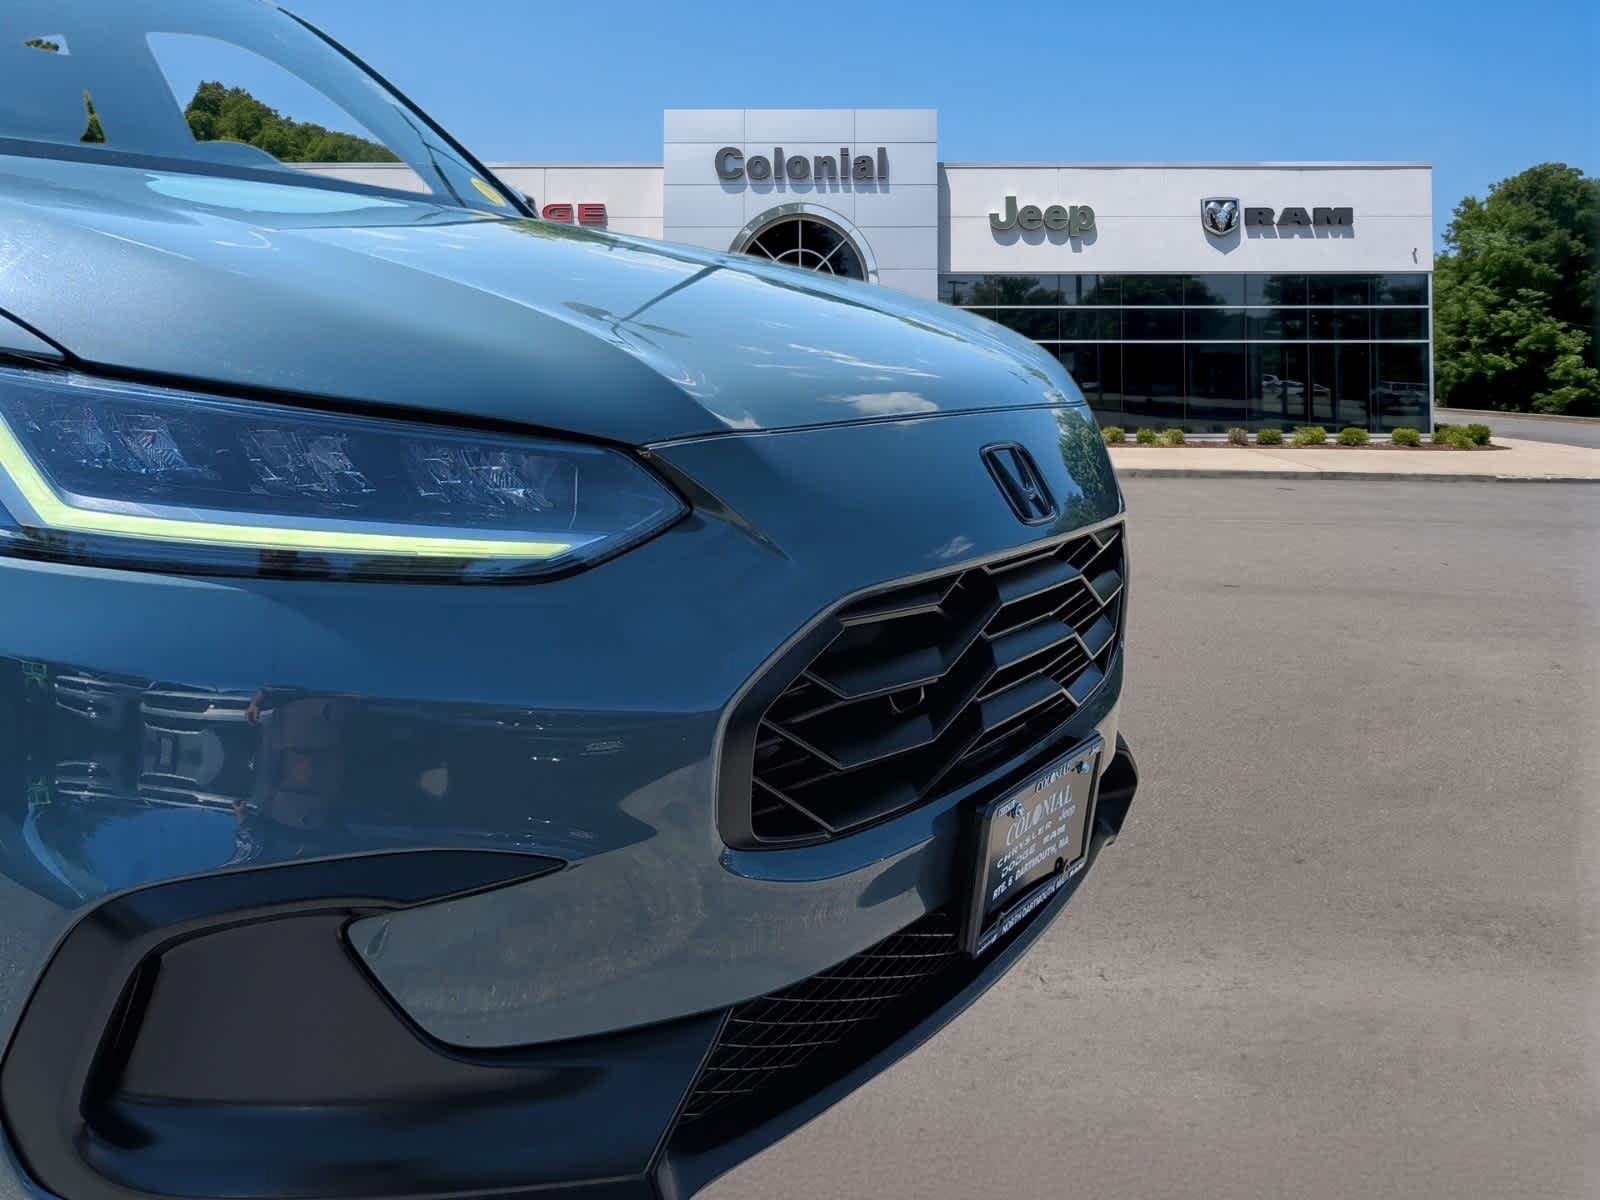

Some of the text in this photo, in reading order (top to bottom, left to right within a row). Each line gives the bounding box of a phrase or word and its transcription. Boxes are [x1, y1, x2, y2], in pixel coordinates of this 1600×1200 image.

[714, 146, 890, 181] Colonial
[989, 195, 1096, 237] Jeep
[1244, 207, 1354, 226] RAM
[1006, 784, 1072, 846] COLONIAL
